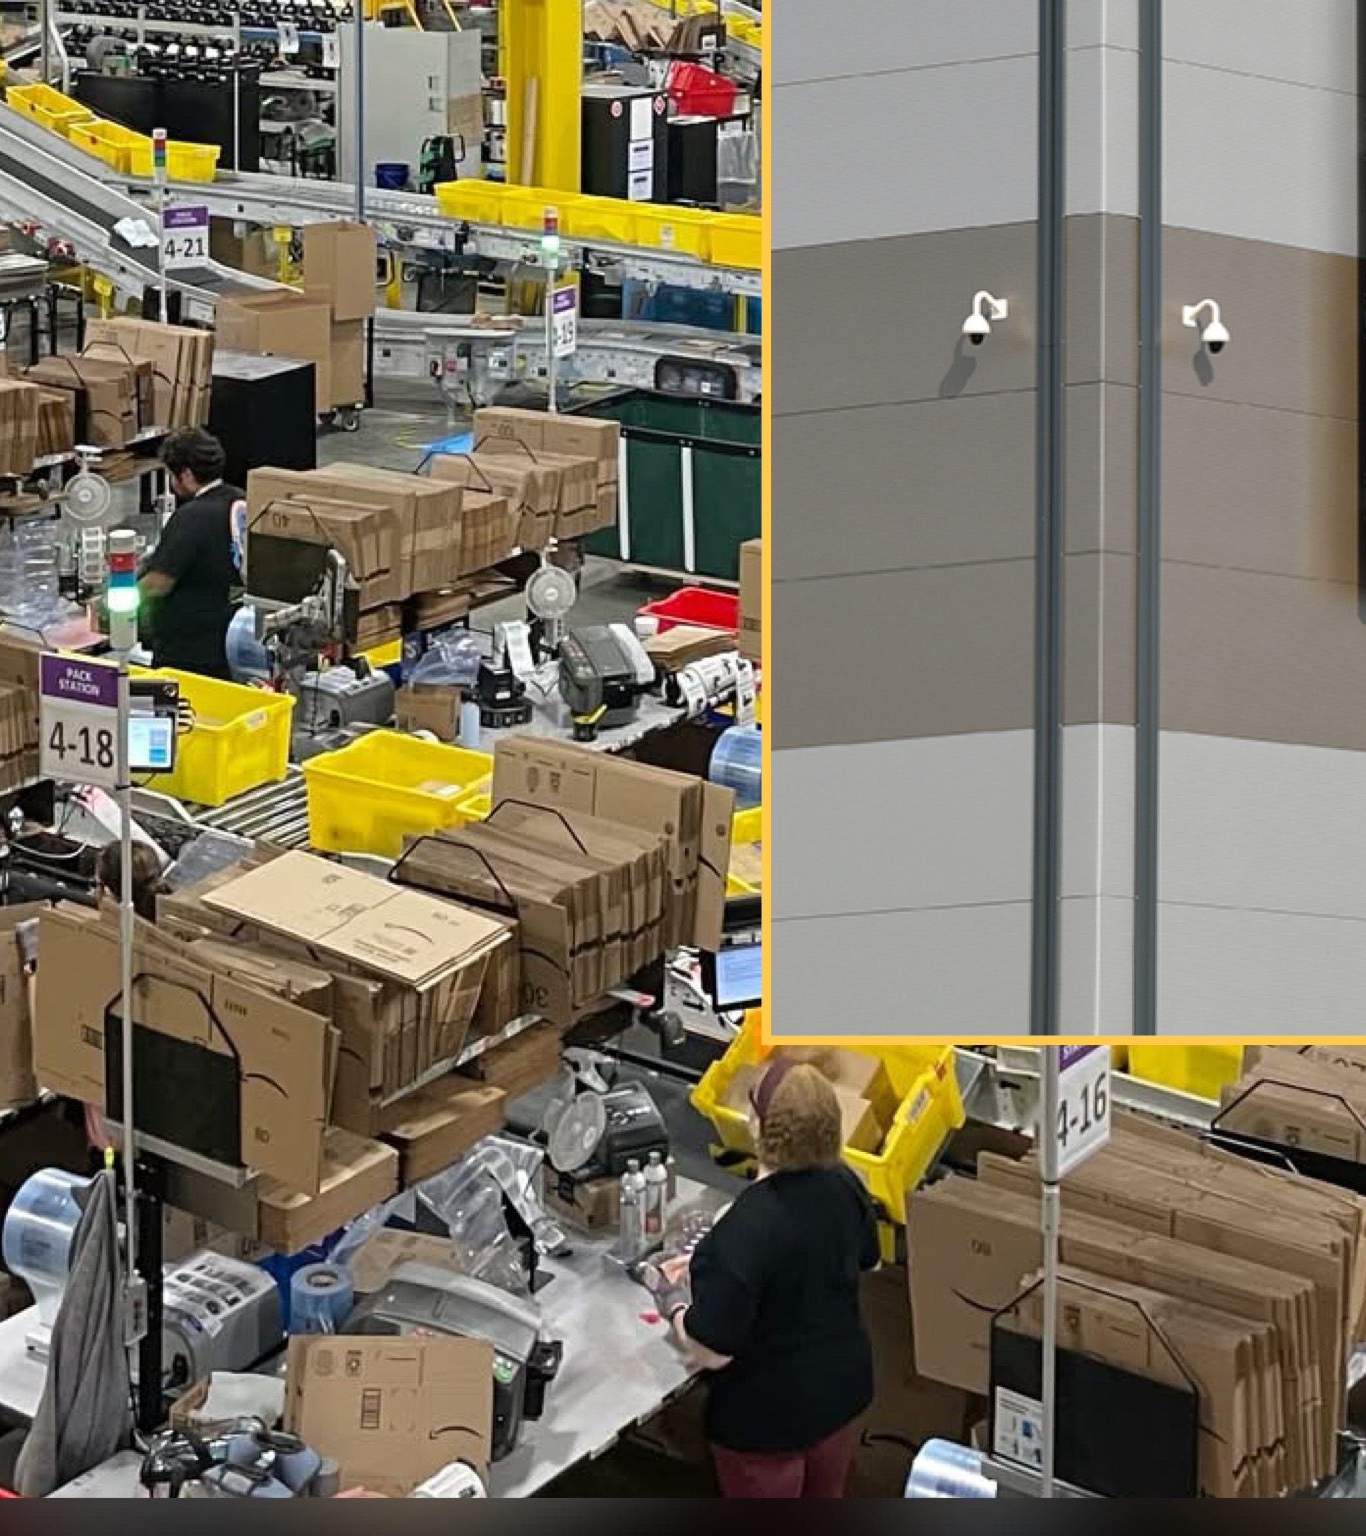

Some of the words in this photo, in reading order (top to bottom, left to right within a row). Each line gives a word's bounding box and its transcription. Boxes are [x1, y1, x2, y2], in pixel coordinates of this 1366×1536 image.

[164, 237, 205, 259] 4-21
[66, 667, 92, 682] PACK
[58, 678, 101, 696] STATION
[49, 721, 114, 769] 4-18
[1057, 1071, 1106, 1147] 4-16
